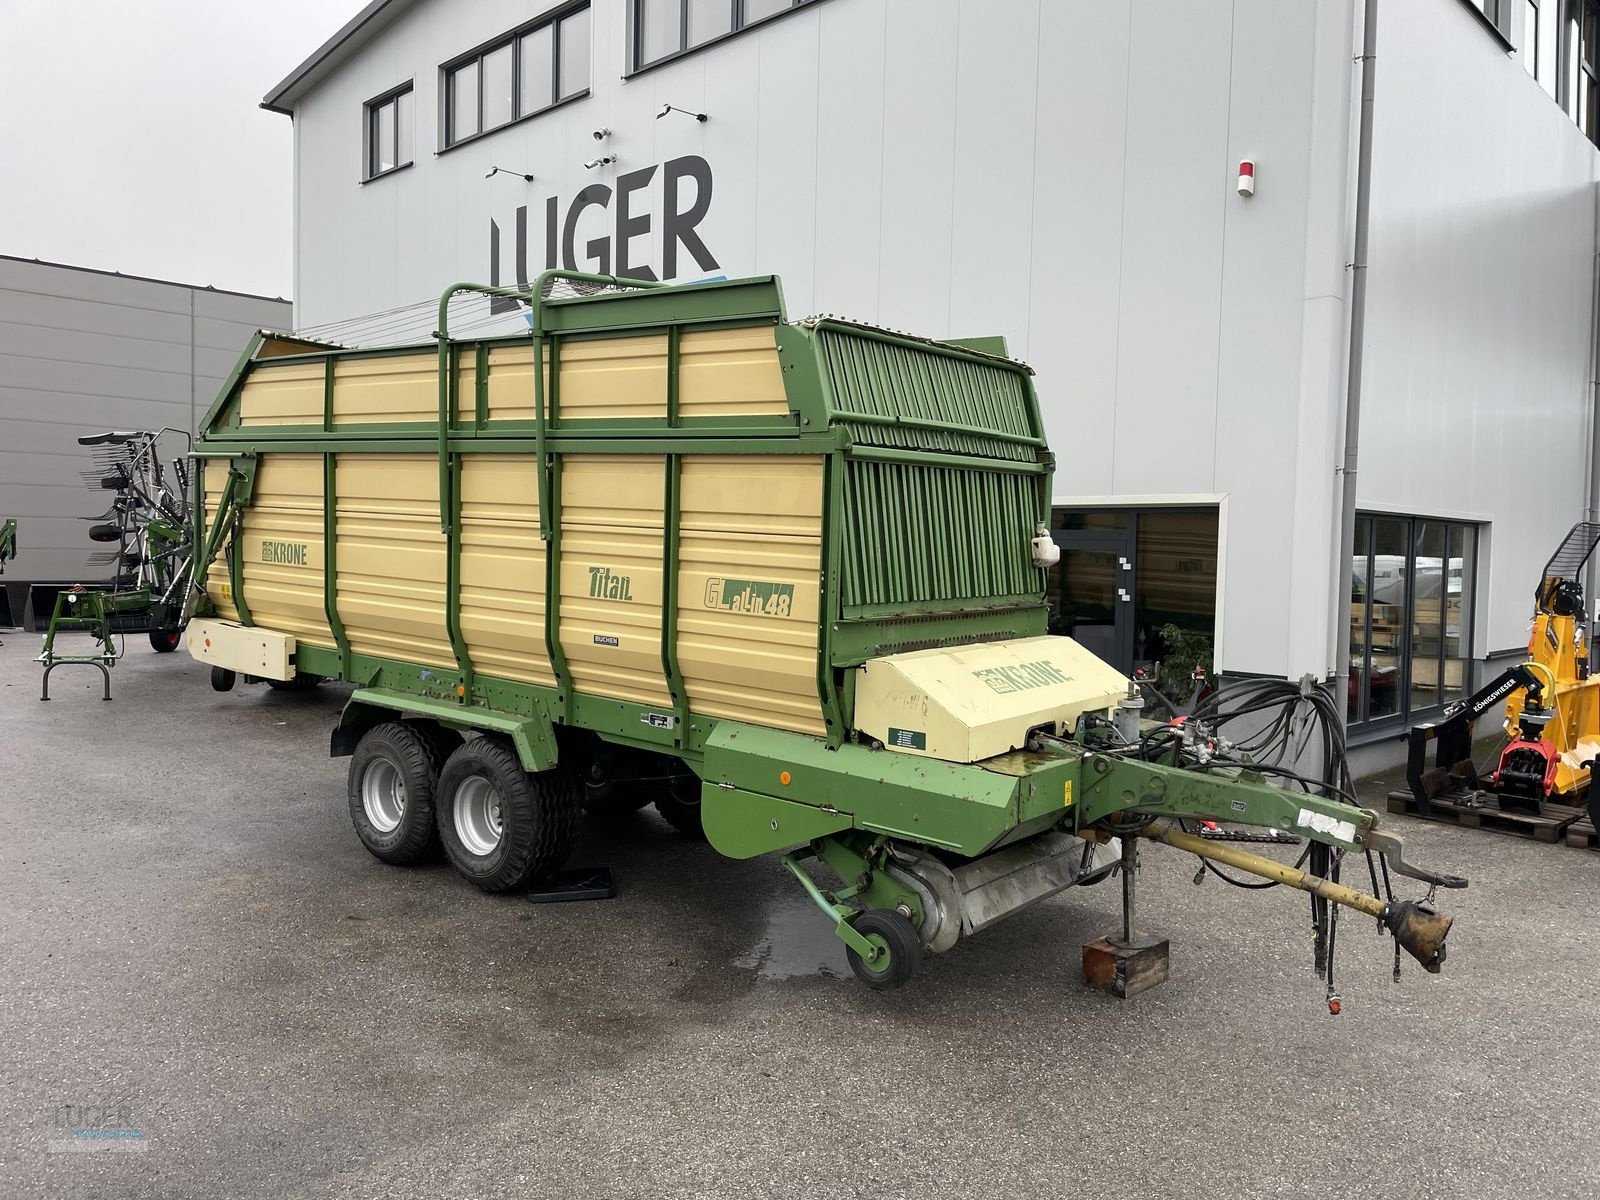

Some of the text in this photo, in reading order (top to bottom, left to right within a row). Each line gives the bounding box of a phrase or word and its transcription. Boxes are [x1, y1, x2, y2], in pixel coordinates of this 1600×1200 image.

[490, 155, 721, 315] LUGER
[273, 541, 308, 566] KRONE
[992, 660, 1075, 691] KRONE
[1473, 678, 1517, 712] KÖNIGSWIESER
